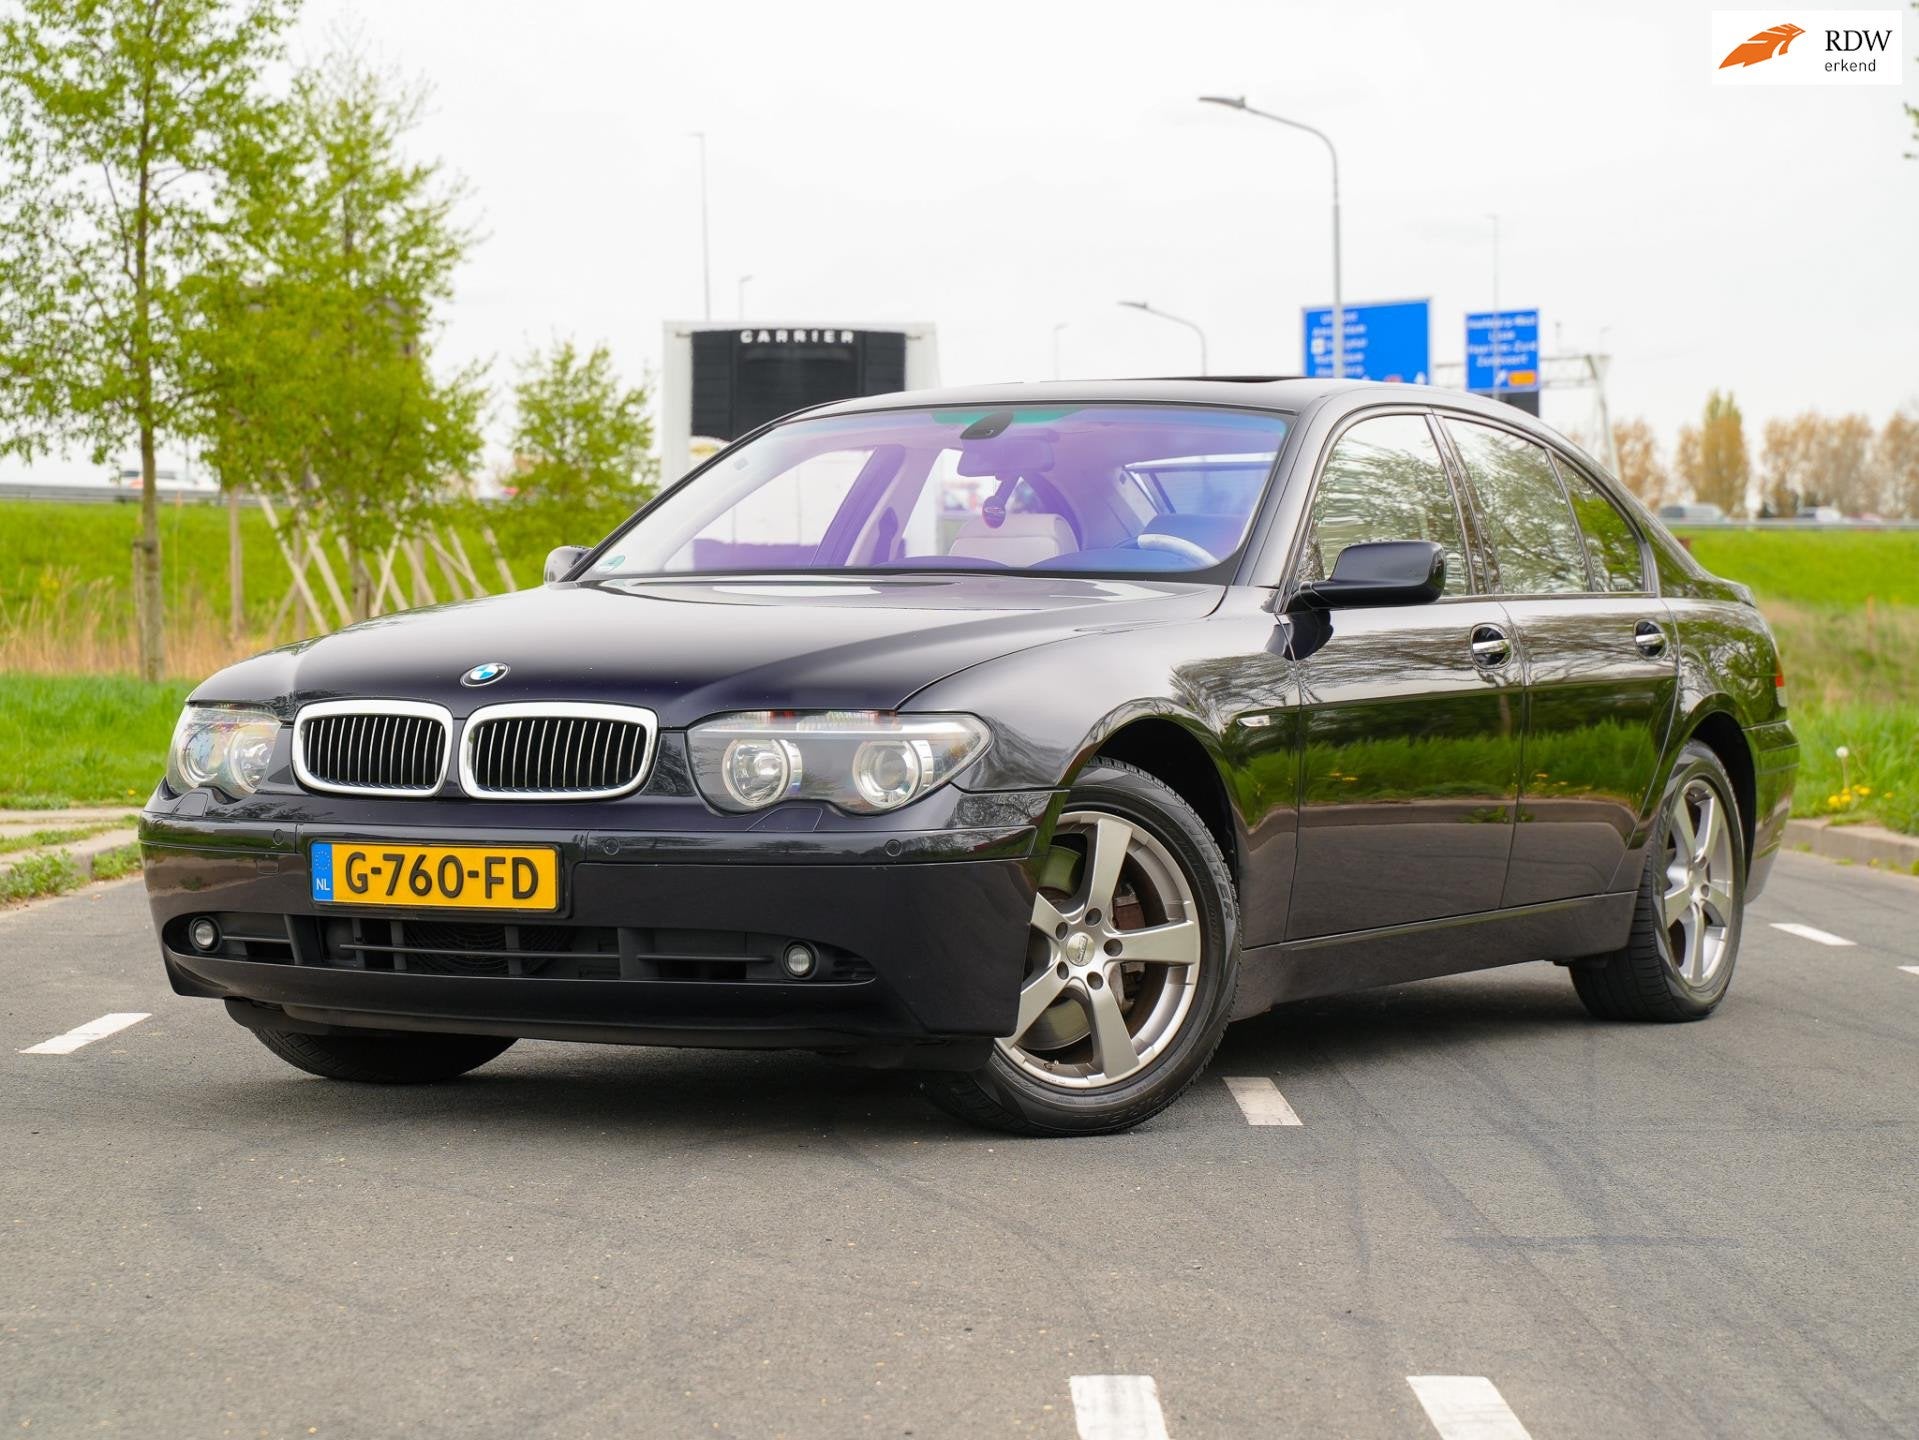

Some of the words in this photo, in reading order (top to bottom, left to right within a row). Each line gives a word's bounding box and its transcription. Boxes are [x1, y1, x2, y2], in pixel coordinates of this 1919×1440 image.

[739, 329, 854, 344] CARRIER
[345, 851, 539, 900] G-760-FD
[316, 878, 331, 891] NL
